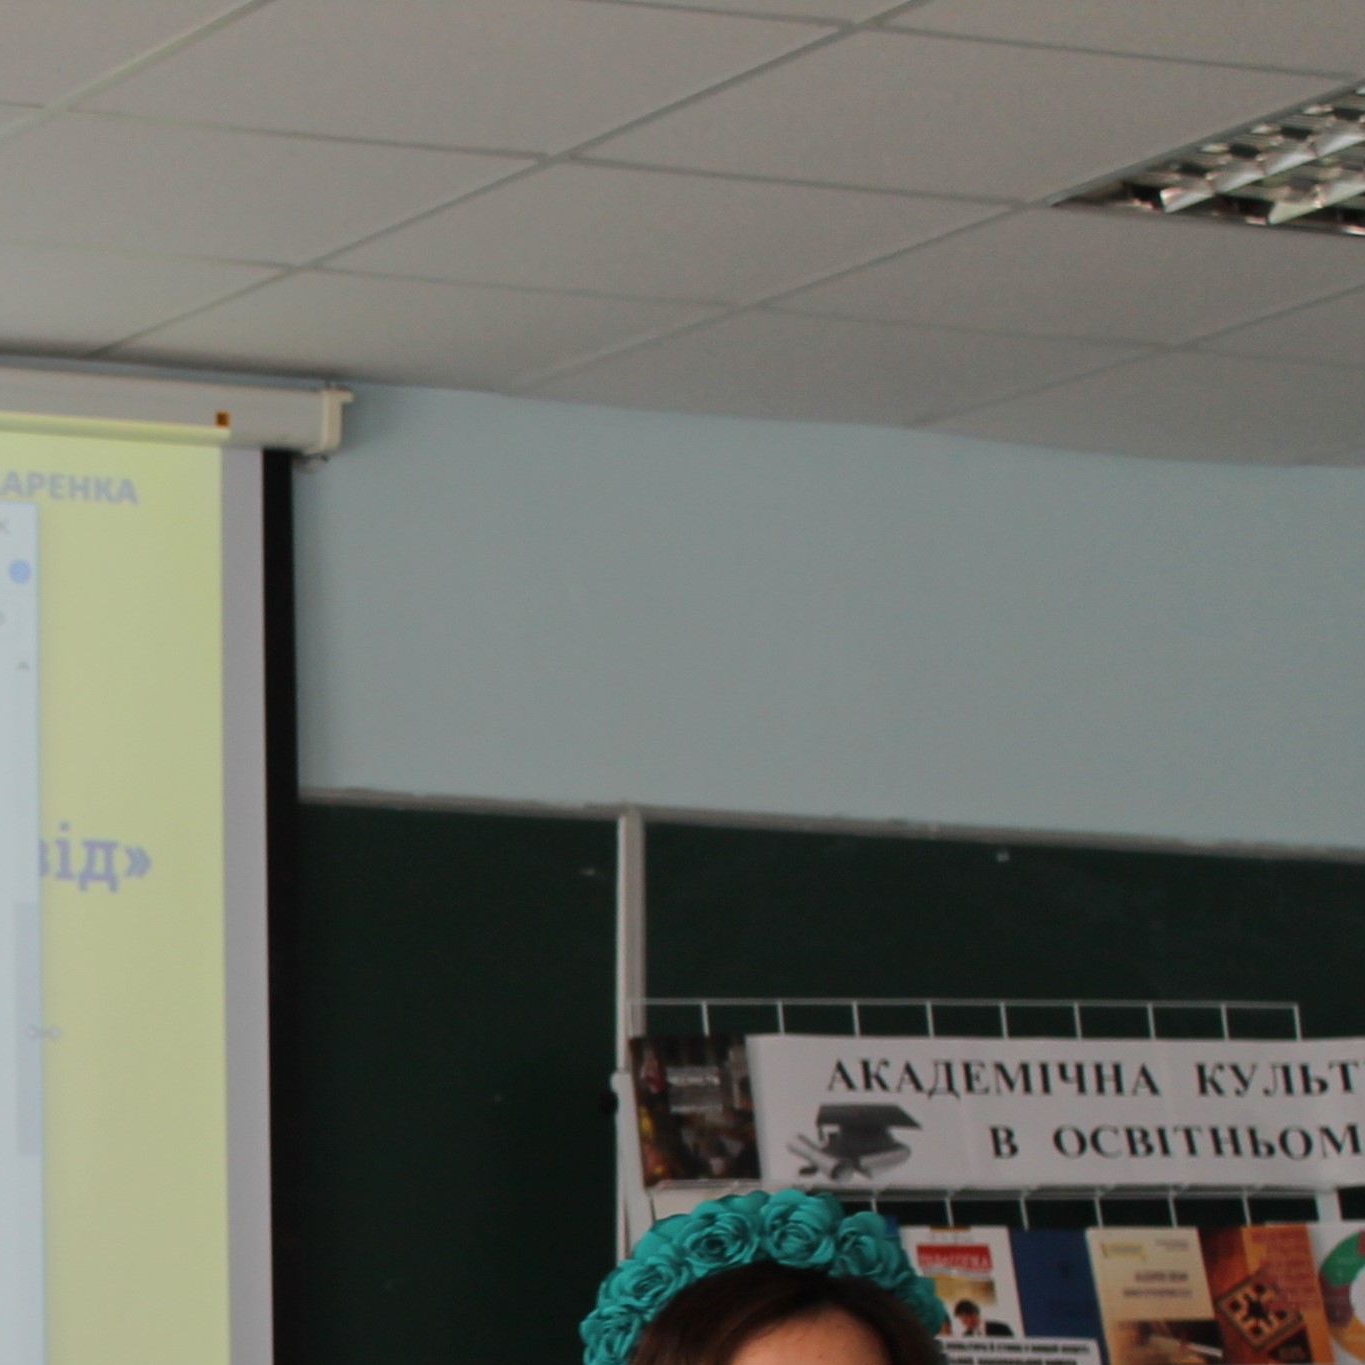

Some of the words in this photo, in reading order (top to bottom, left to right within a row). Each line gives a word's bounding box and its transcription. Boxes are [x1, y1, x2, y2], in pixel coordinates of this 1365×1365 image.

[827, 1058, 1161, 1101] АКАДЕМІЧНА
[1194, 1059, 1361, 1098] КУЛЬТ
[988, 1124, 1020, 1159] В
[1052, 1122, 1365, 1161] ОСВІТНЬОМ
